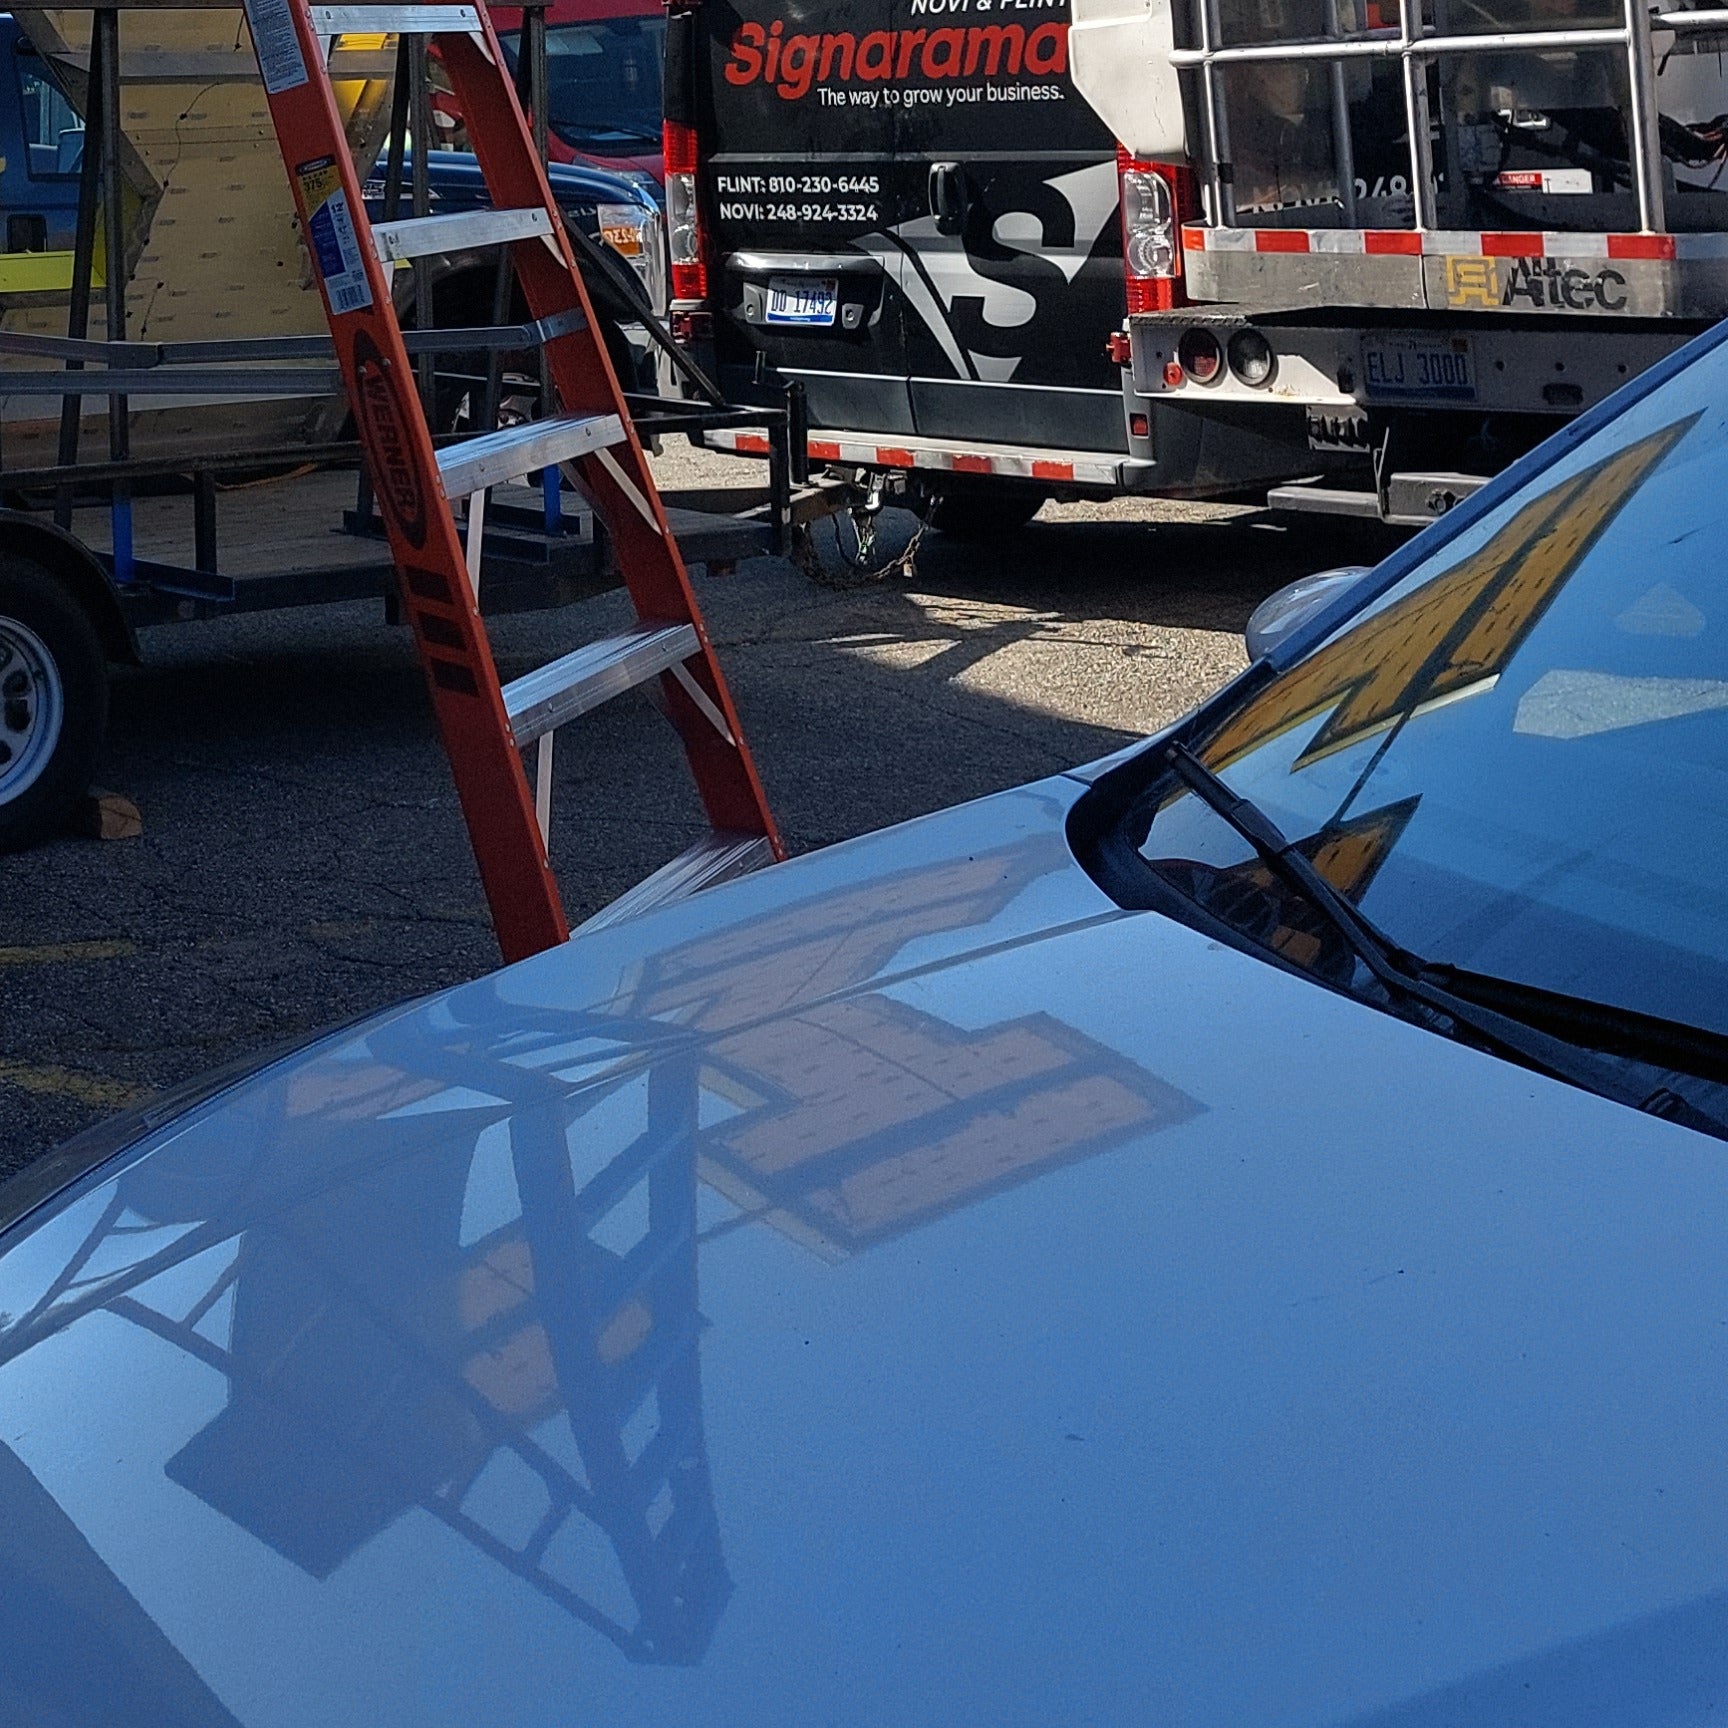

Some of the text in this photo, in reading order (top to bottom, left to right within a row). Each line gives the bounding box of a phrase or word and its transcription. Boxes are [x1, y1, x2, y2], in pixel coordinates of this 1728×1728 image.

[724, 20, 1071, 100] Signarama
[817, 82, 1065, 108] The way to grow your business.
[717, 175, 880, 194] FLINT: 810-230-6445
[719, 202, 878, 221] NOVI: 248-924-3324
